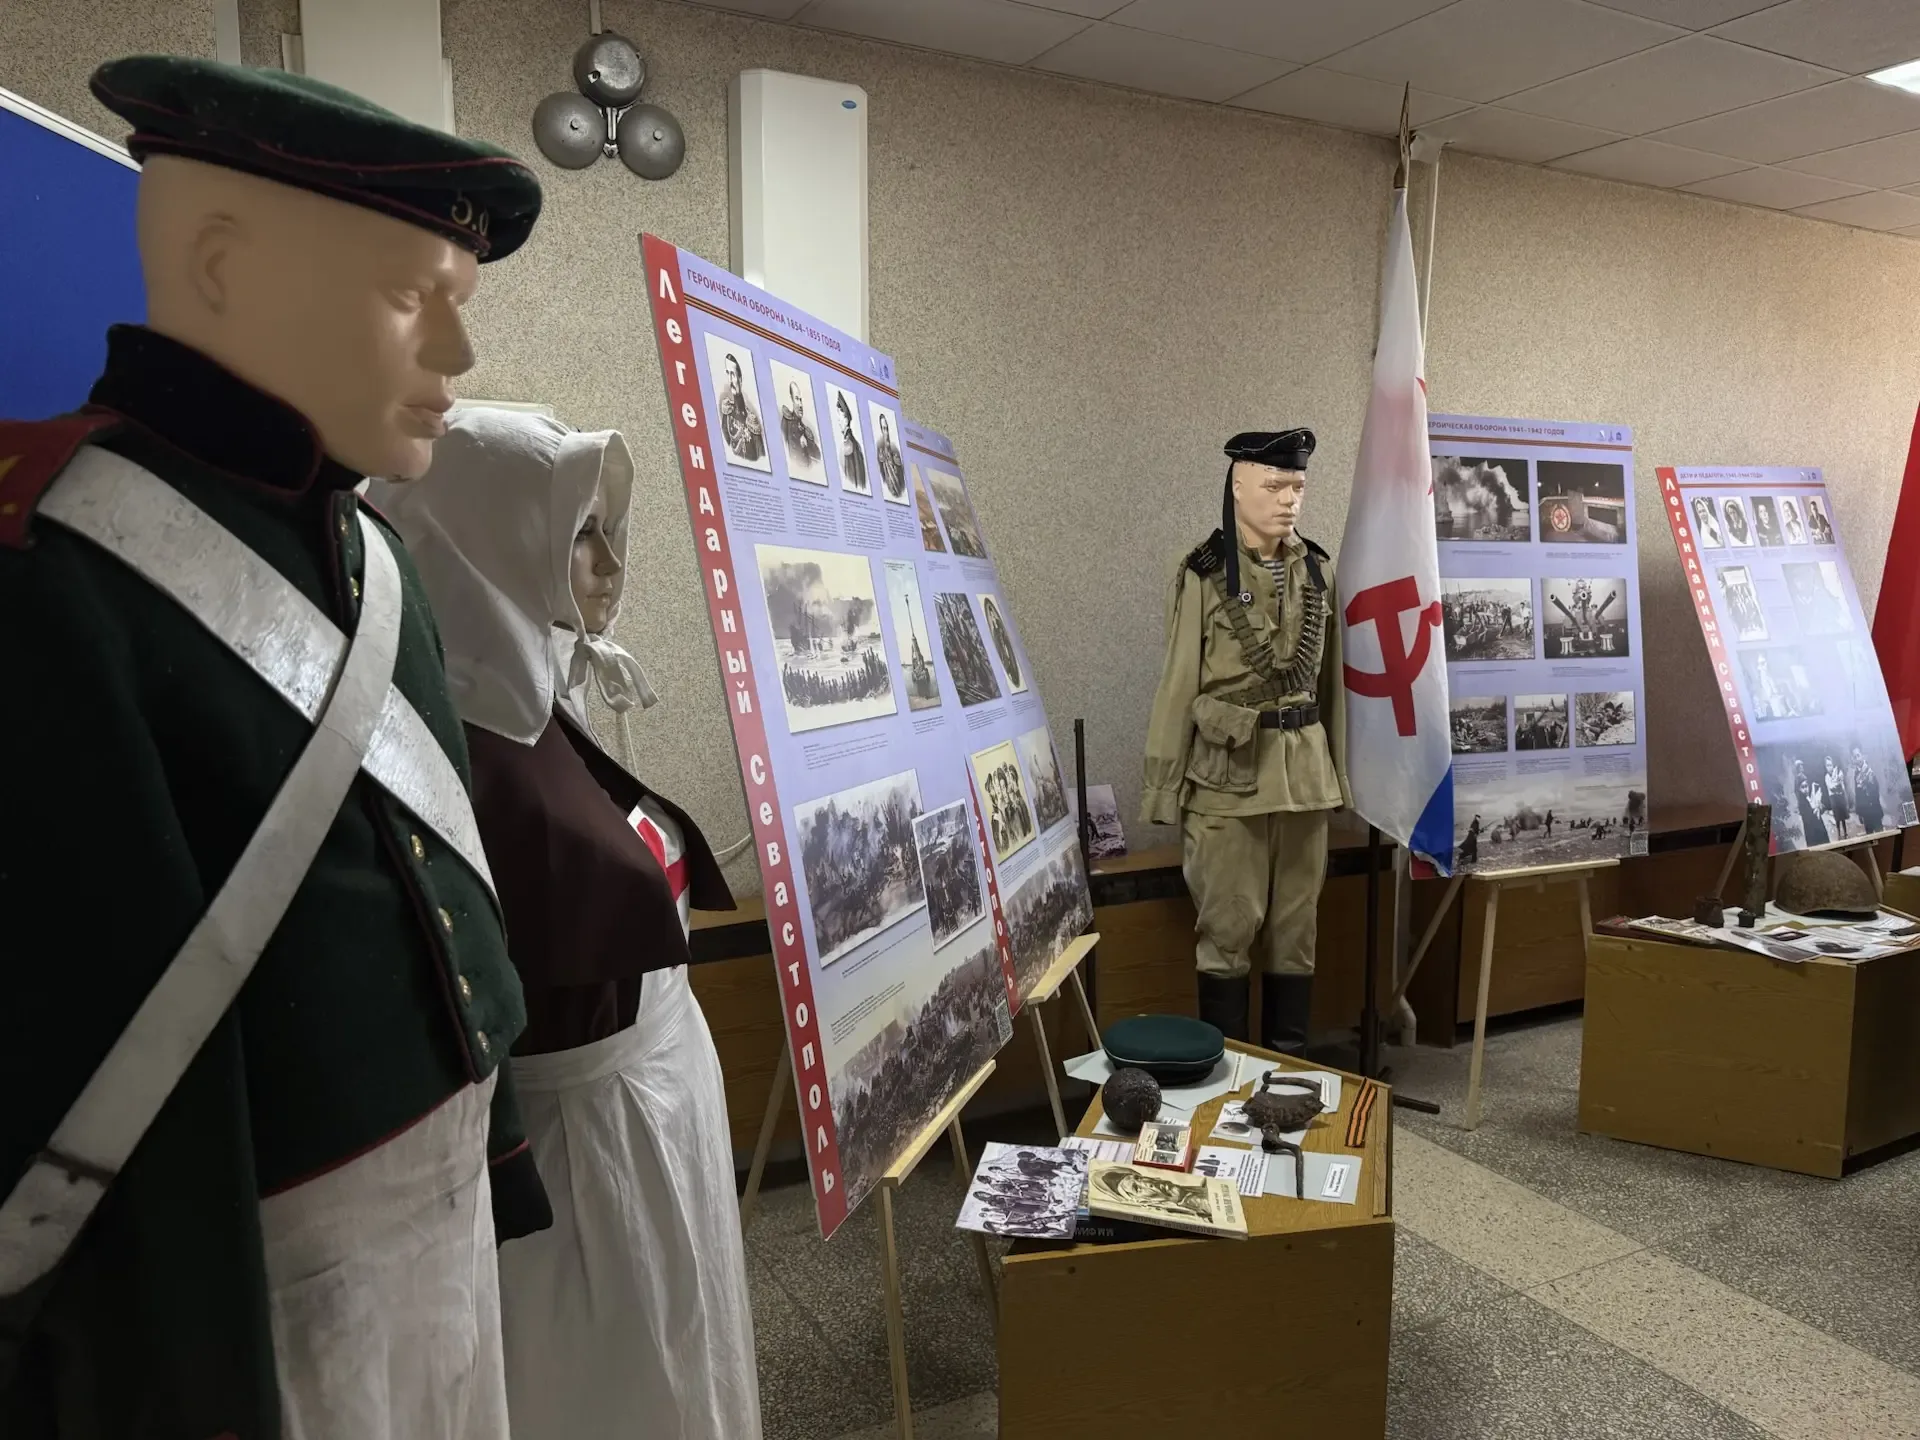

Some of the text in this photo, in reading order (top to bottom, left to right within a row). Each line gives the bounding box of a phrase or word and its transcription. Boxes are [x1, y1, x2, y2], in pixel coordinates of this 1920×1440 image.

[687, 268, 748, 307] ГЕРОИЧЕСКАЯ
[749, 298, 786, 324] ОБОРОНА
[821, 334, 842, 352] ГОДОВ
[1428, 420, 1473, 431] ЕРОИЧЕСКАЯ
[1474, 424, 1507, 432] ОБОРОНА
[1544, 428, 1565, 436] ГОДОВ
[659, 267, 835, 1195] Легендарный Севастополь
[1718, 661, 1763, 806] Севастопо
